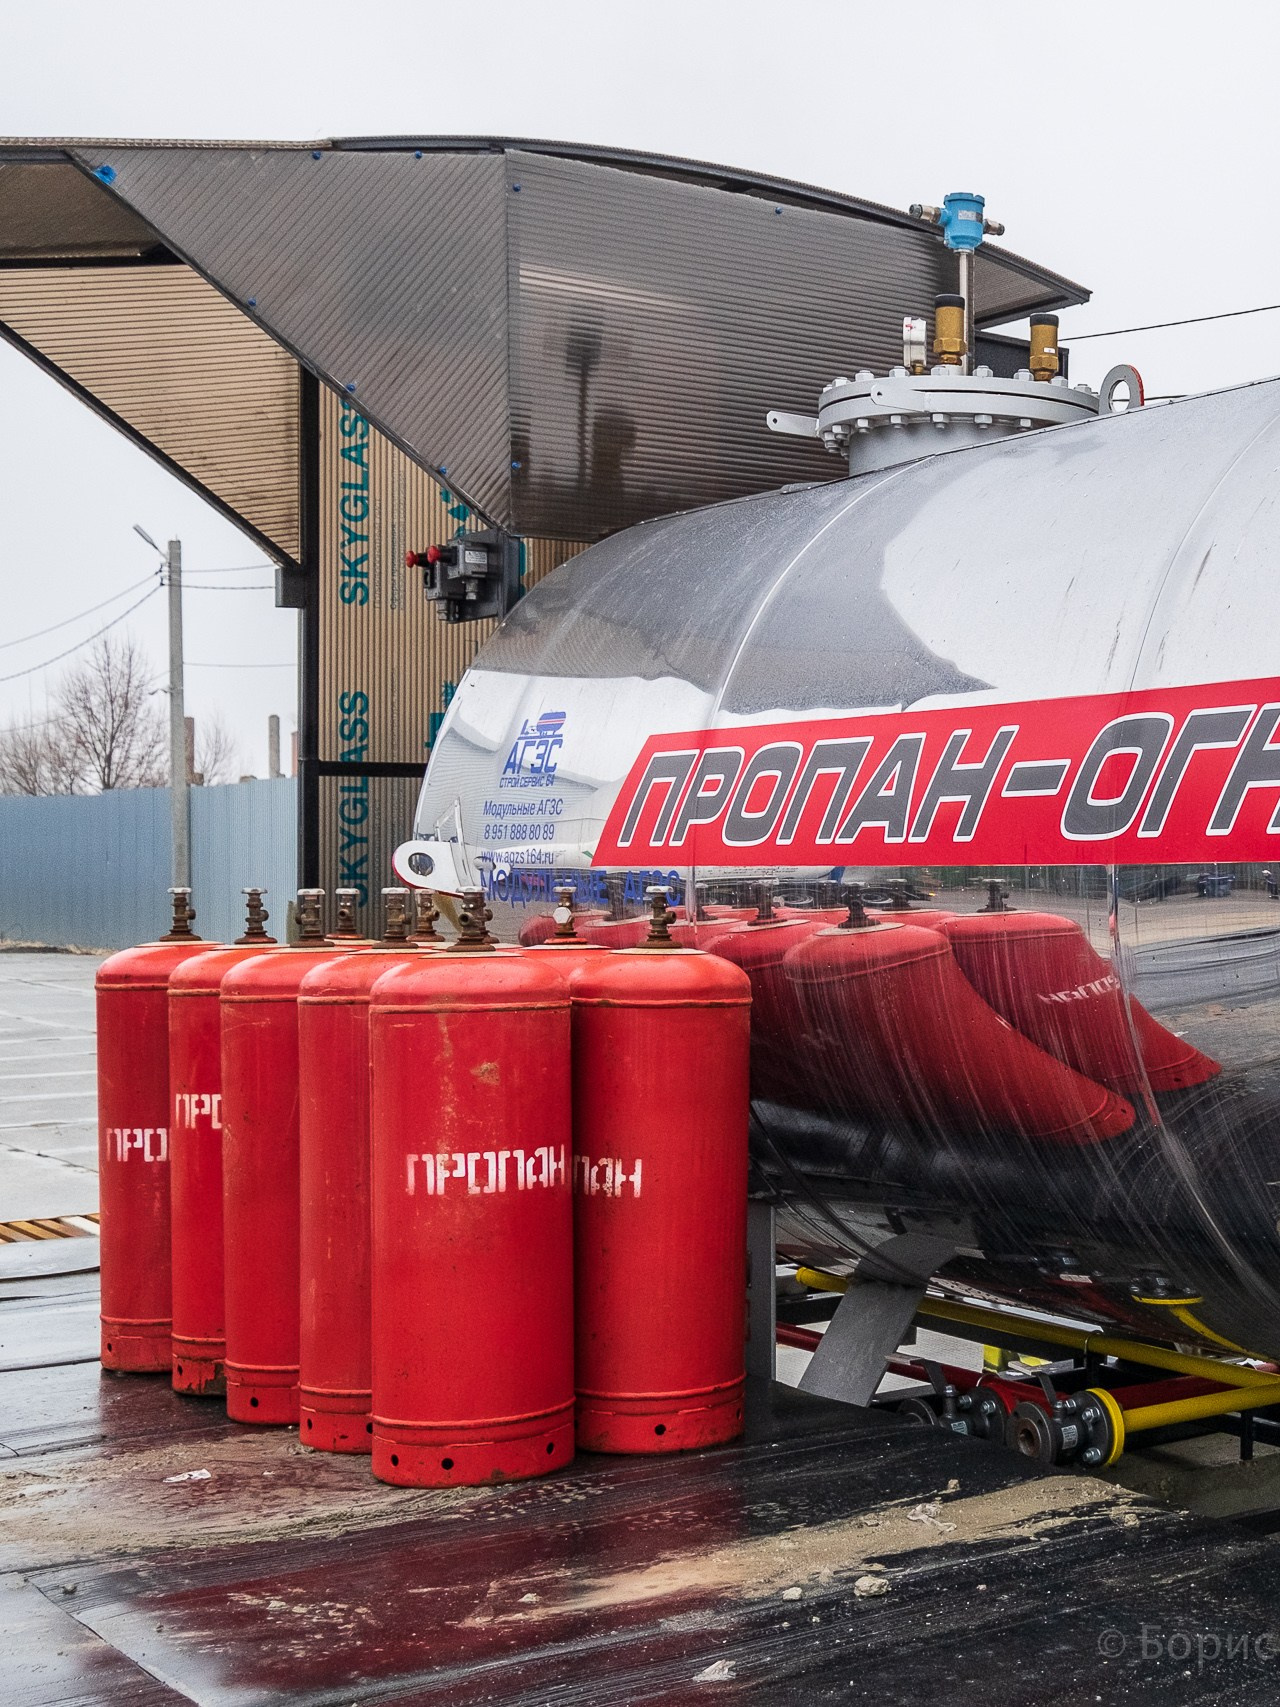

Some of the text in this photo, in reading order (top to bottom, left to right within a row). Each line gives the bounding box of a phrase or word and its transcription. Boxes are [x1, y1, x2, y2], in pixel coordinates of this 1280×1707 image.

[502, 739, 564, 775] АГЗС
[499, 775, 519, 788] СТРОЙ
[519, 775, 545, 788] СЕРВИС
[483, 798, 564, 820] Модульные АГЗС
[484, 824, 555, 840] 8 951 888 80 89
[406, 1144, 565, 1196] ПРОПАН
